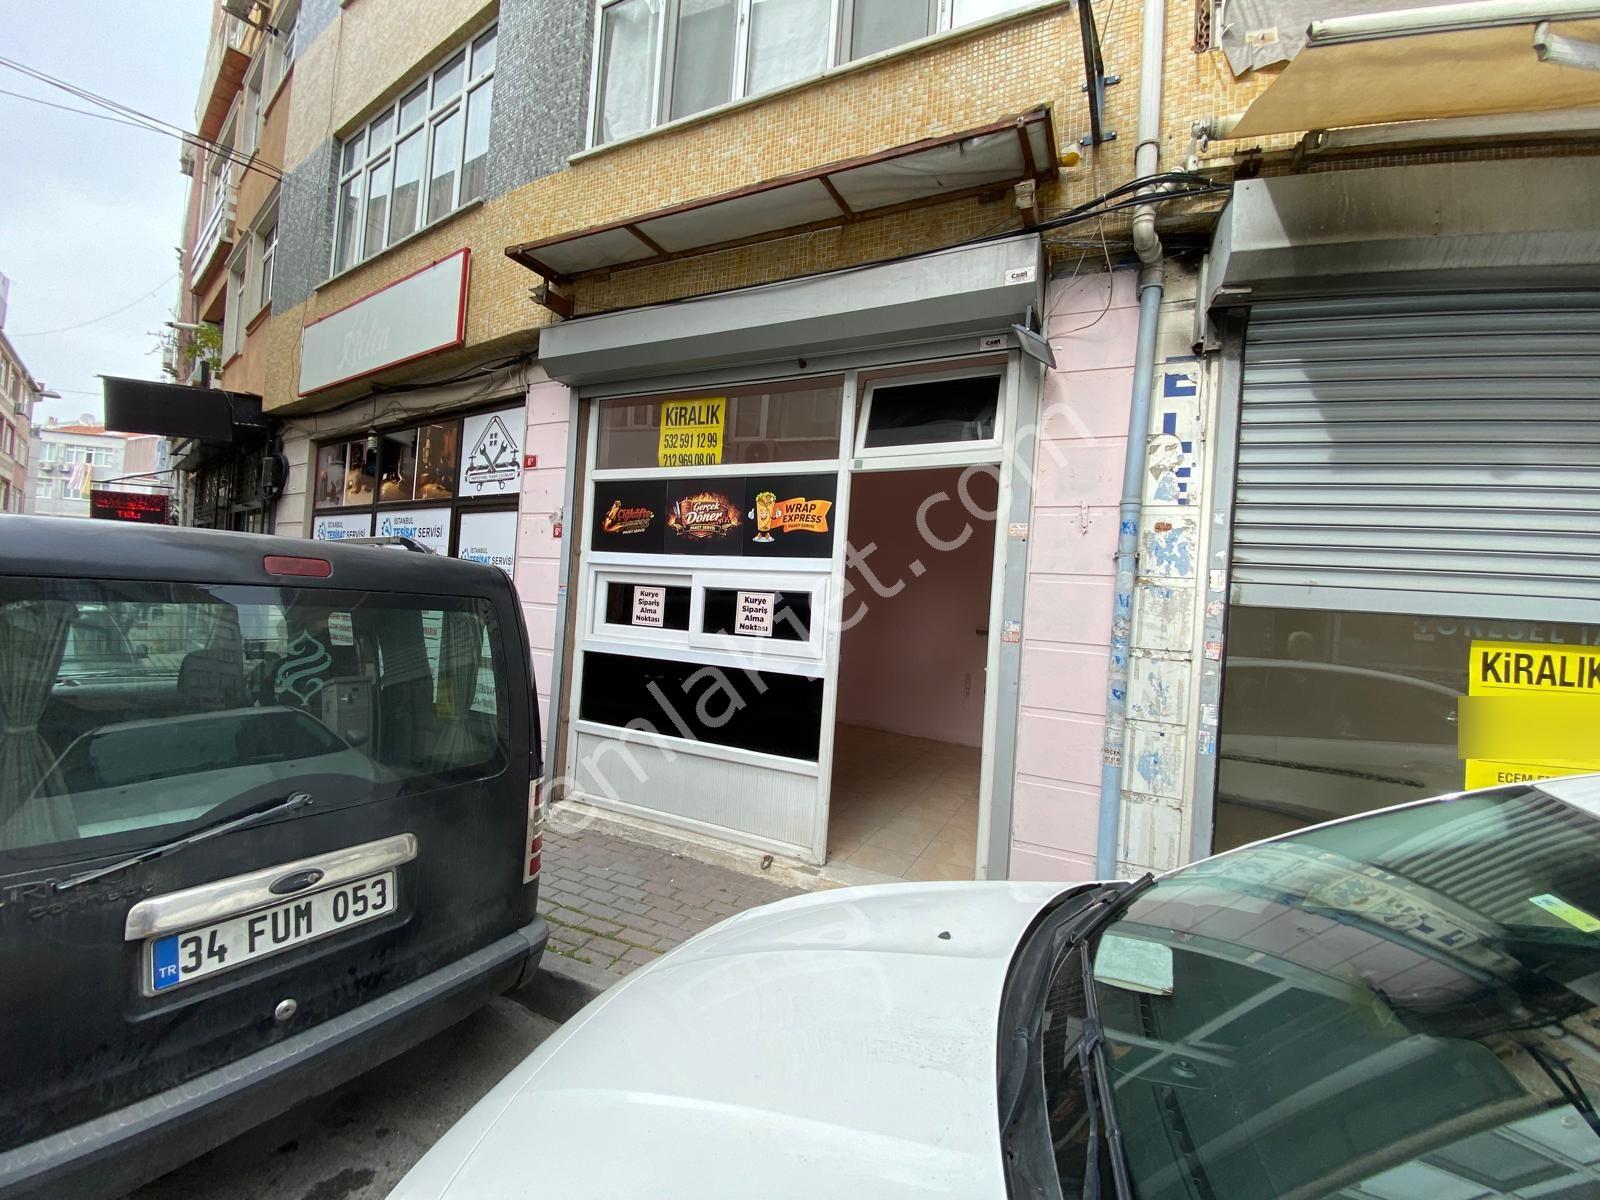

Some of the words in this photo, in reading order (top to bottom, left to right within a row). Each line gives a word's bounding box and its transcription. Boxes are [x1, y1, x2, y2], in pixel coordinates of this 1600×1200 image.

[664, 433, 678, 449] 532
[680, 433, 693, 448] 591
[697, 433, 706, 448] 12
[707, 432, 717, 448] 99
[663, 453, 677, 467] 212
[679, 453, 693, 466] 969
[695, 453, 704, 466] 08
[706, 452, 715, 465] 00
[693, 501, 720, 512] Gerçek
[785, 503, 816, 513] WRAP
[685, 510, 723, 525] Döner
[782, 514, 822, 524] EXPRESS
[327, 529, 346, 539] TESİSAT
[346, 528, 366, 537] SERVİSİ
[393, 526, 417, 537] TESİSAT
[418, 525, 443, 538] SERVİSİ
[491, 555, 514, 566] SERVİSİ
[640, 590, 659, 598] Kurye
[638, 598, 660, 607] Sipariş
[744, 596, 767, 605] Kurye
[742, 605, 768, 614] Sipariş
[635, 615, 660, 623] Noktası
[745, 615, 764, 623] Alma
[739, 623, 768, 632] Noktası
[180, 929, 228, 974] 34
[248, 901, 313, 953] FUM
[332, 878, 387, 923] 053
[159, 964, 177, 978] TR
